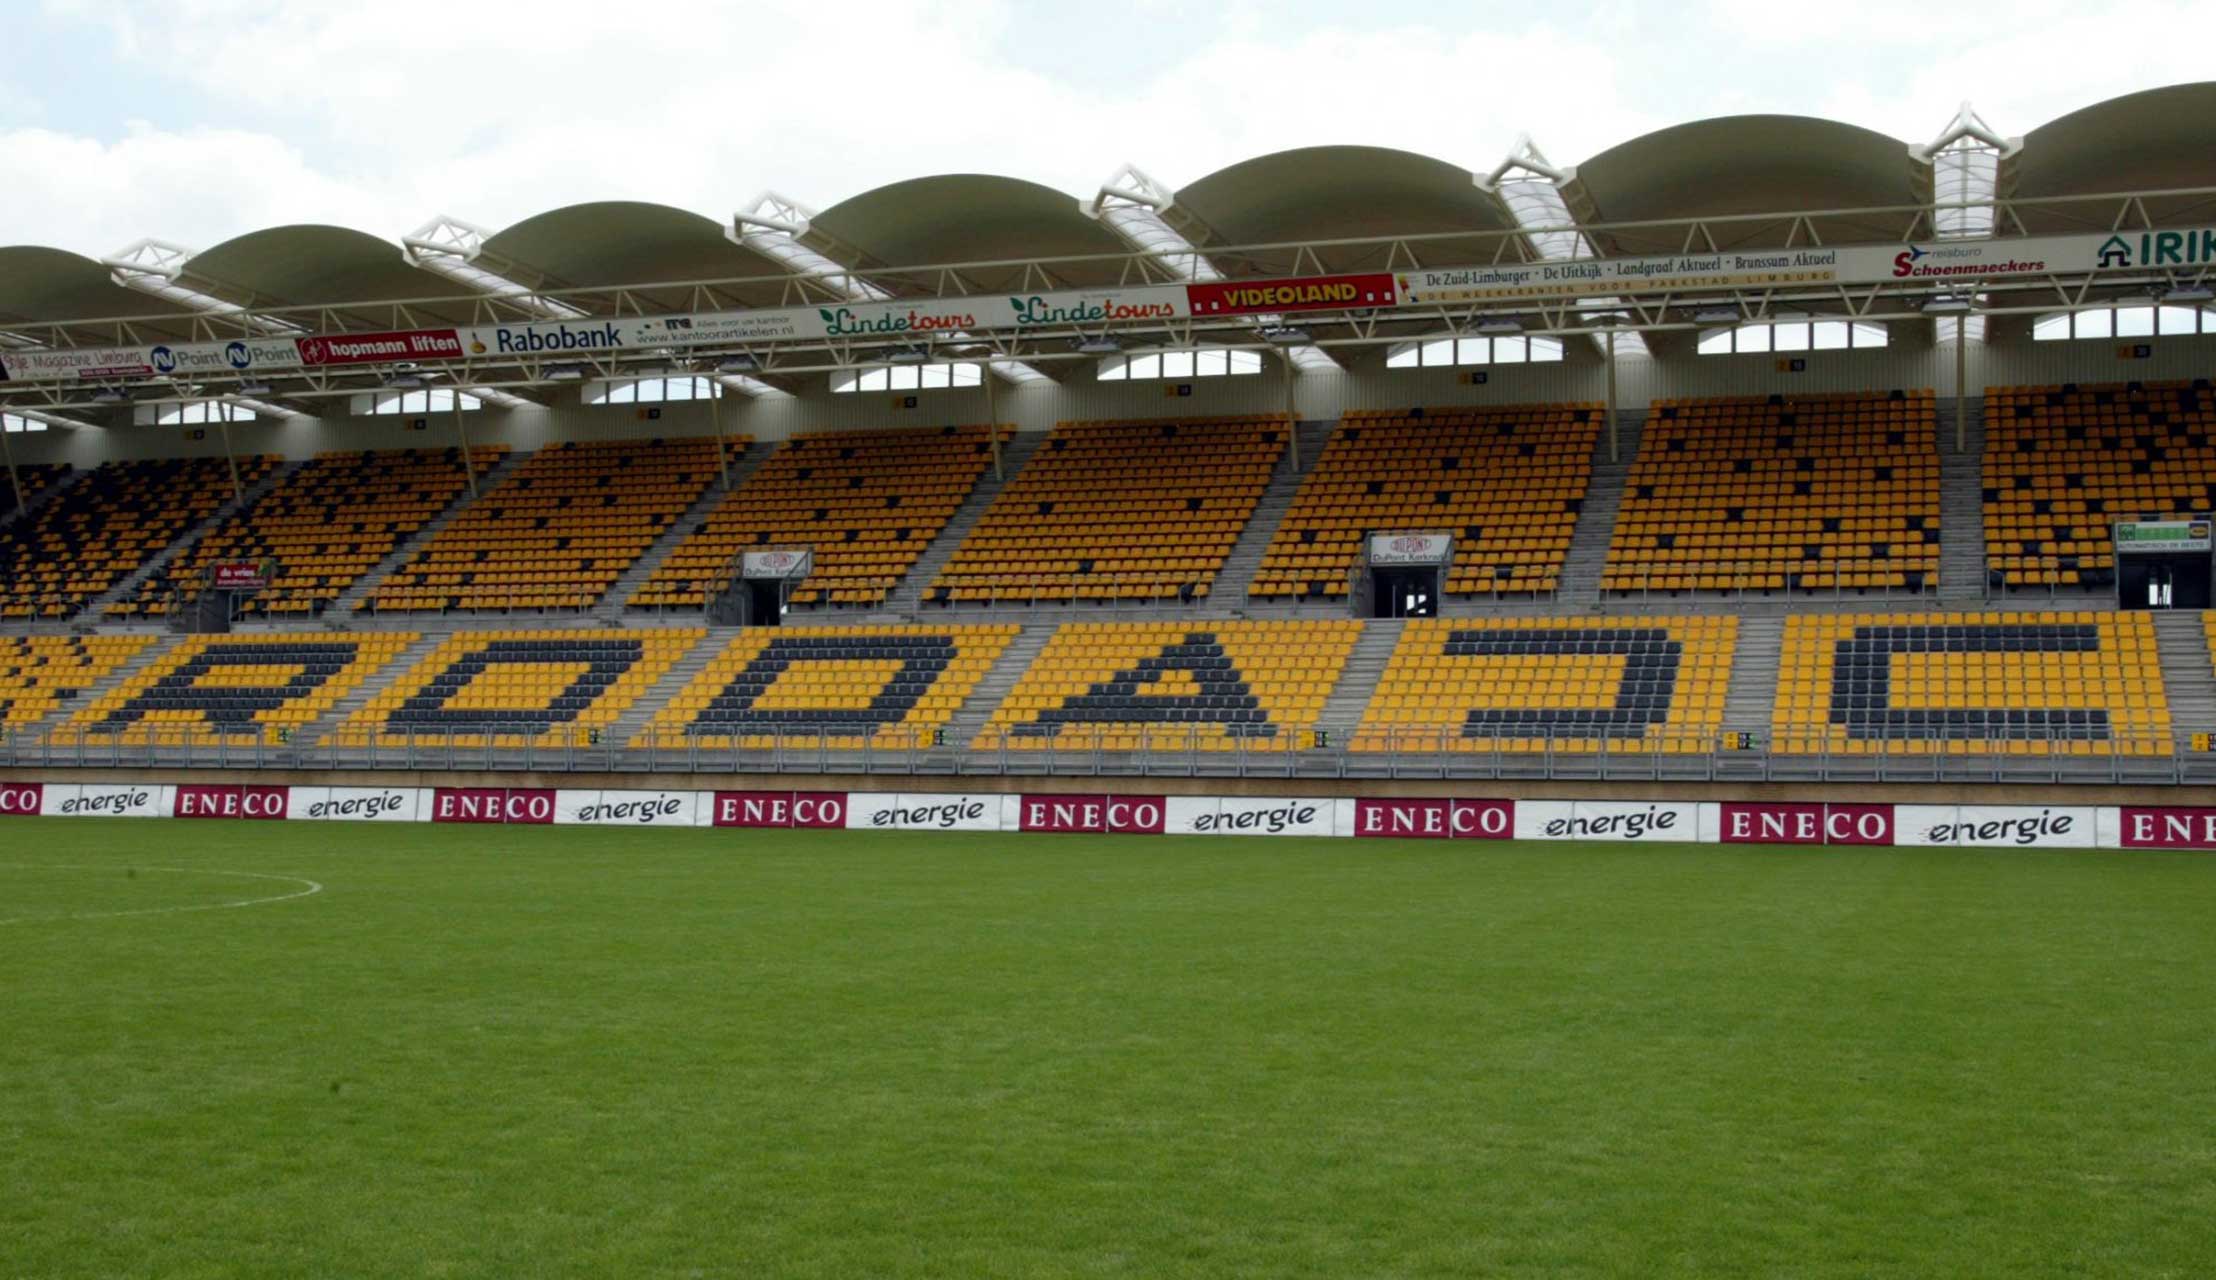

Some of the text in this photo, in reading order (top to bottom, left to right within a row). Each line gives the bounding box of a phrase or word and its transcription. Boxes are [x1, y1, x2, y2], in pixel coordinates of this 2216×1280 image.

[1427, 250, 1836, 287] De Zuid-Limburger De Uitkijk Landgraaf Aktueel Brunssum Aktueel
[1746, 271, 1831, 284] LIMBURG
[1893, 251, 2045, 277] Schoenmaeckers
[1223, 283, 1358, 307] VIDEOLAND
[826, 307, 976, 335] Lindetours
[1016, 296, 1175, 324] Lindetours
[328, 335, 459, 358] hopmann liften
[496, 322, 623, 352] Rabobank
[636, 324, 795, 344] www.kantoorartikelen.nl
[177, 350, 222, 366] Point
[253, 345, 298, 362] Point
[0, 787, 149, 814] CO energie
[180, 790, 403, 818] ENECO energie
[440, 794, 681, 822] ENECO energie
[720, 797, 985, 827] ENECO energie
[1028, 801, 1316, 833] ENECO energie
[1364, 805, 1677, 838] ENECO energie
[1731, 809, 2073, 844] ENECO energie
